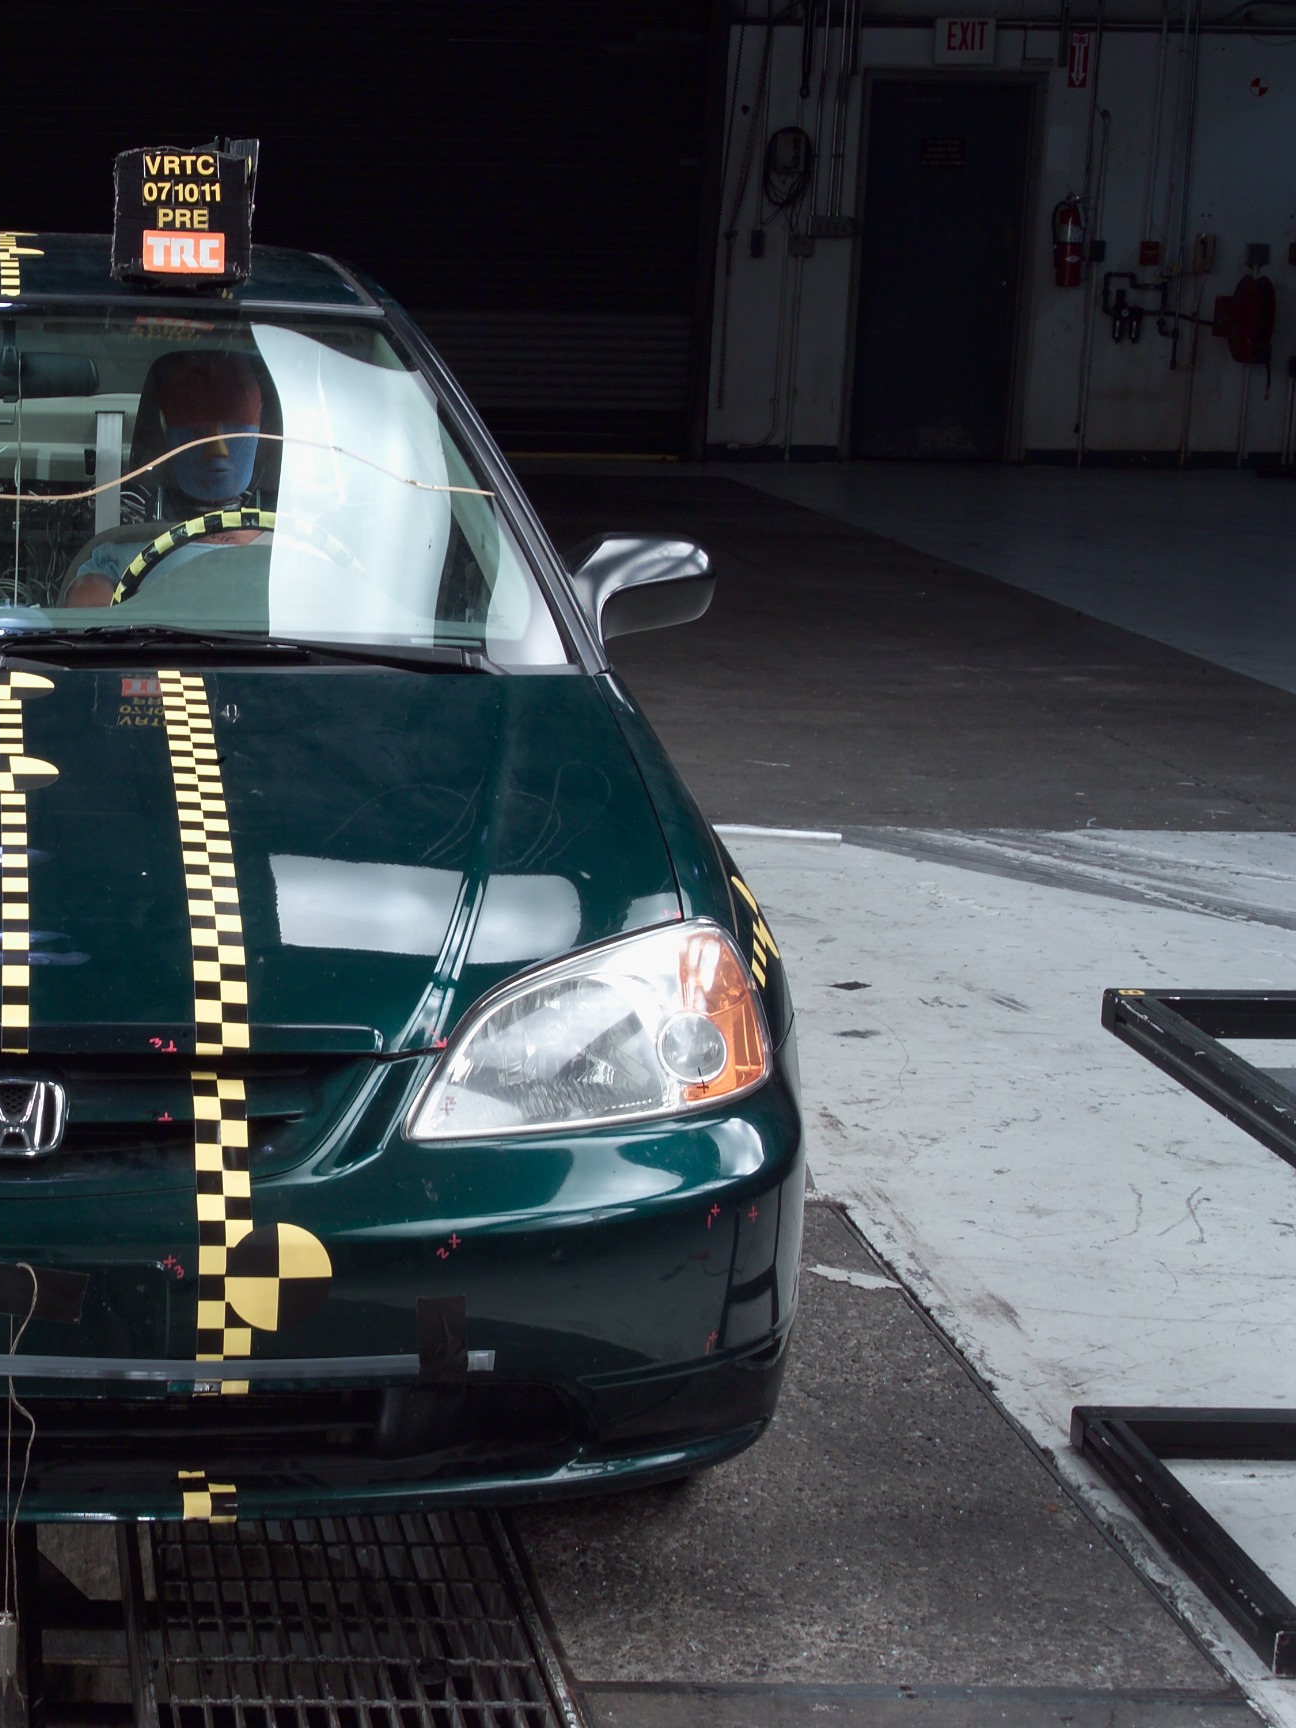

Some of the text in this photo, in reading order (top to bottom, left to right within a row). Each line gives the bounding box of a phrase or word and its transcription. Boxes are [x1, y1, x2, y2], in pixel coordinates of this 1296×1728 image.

[947, 21, 988, 50] EXIT
[145, 155, 215, 175] VRTC
[143, 182, 221, 202] 071011
[158, 208, 208, 229] PRE
[147, 236, 220, 268] TRC
